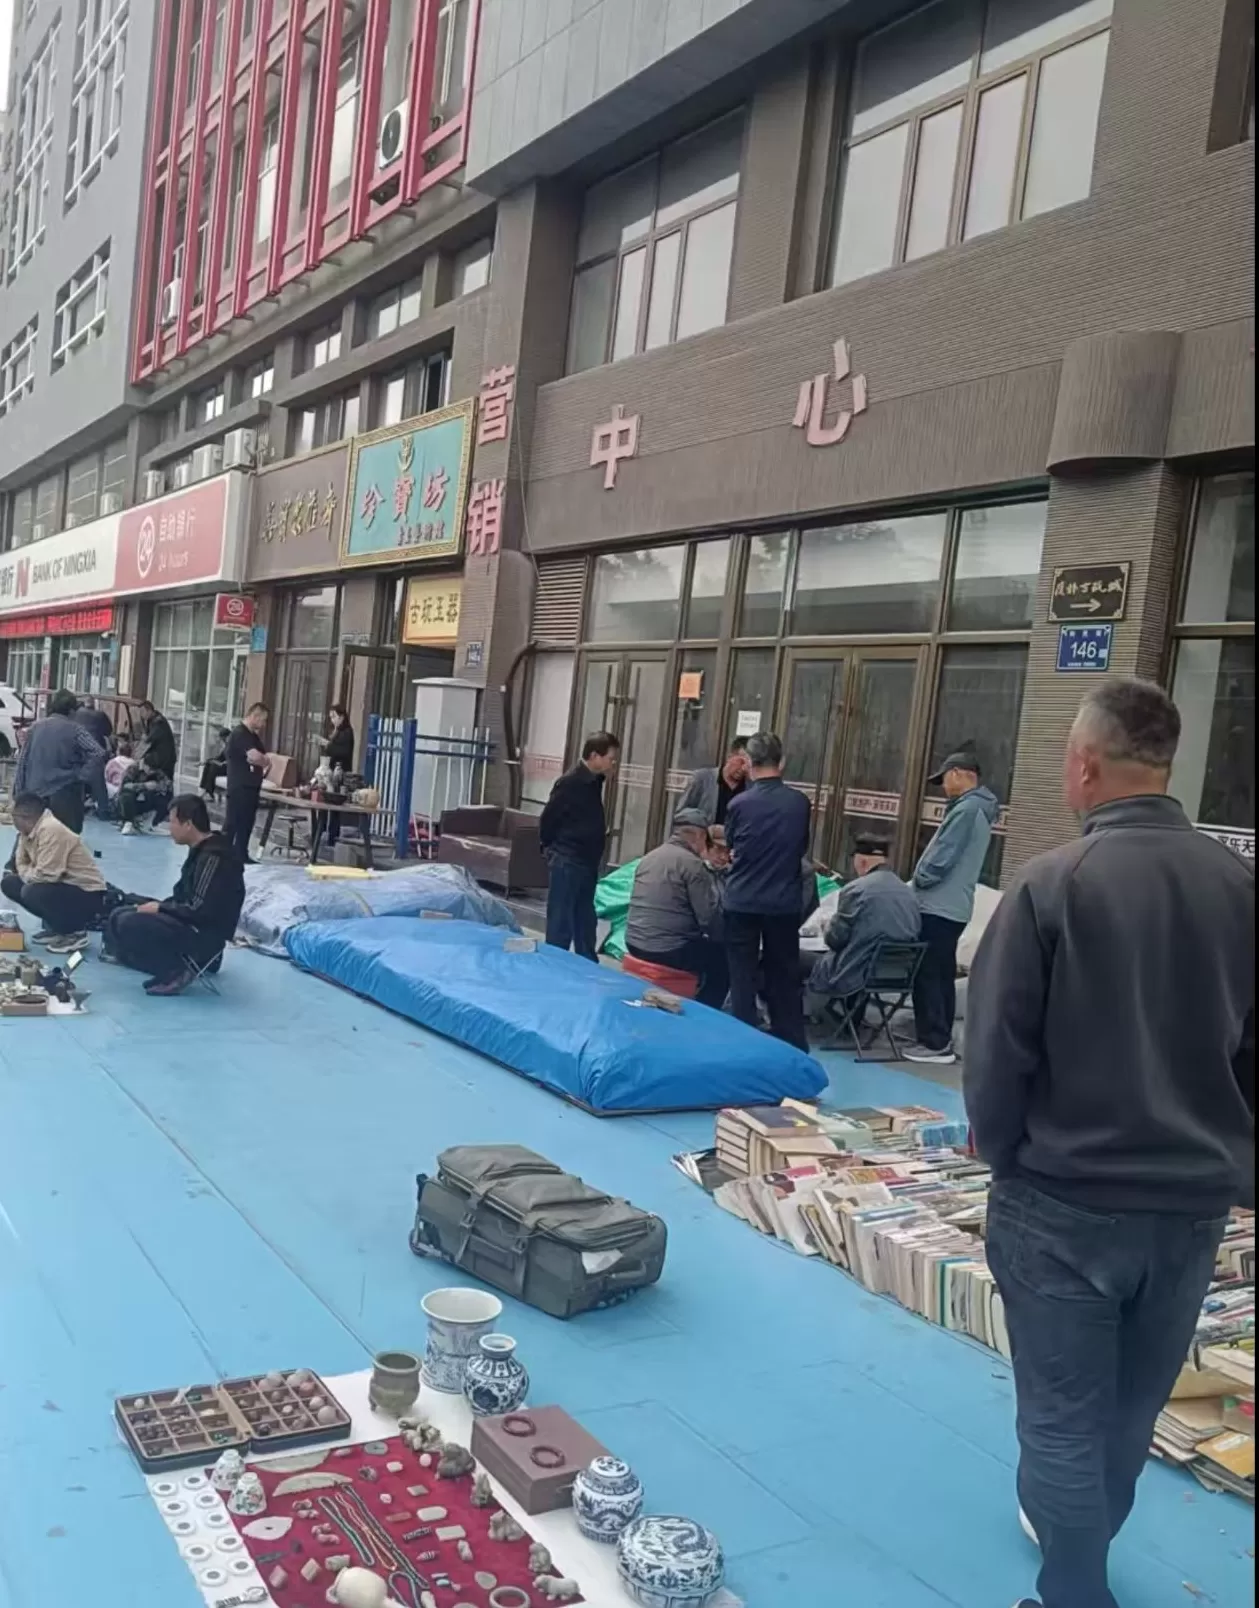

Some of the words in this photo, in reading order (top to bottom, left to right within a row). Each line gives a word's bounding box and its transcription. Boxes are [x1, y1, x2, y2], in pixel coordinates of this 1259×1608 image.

[467, 365, 515, 558] 营销
[32, 561, 52, 584] BANK
[52, 557, 63, 580] OF
[1069, 641, 1098, 659] 146
